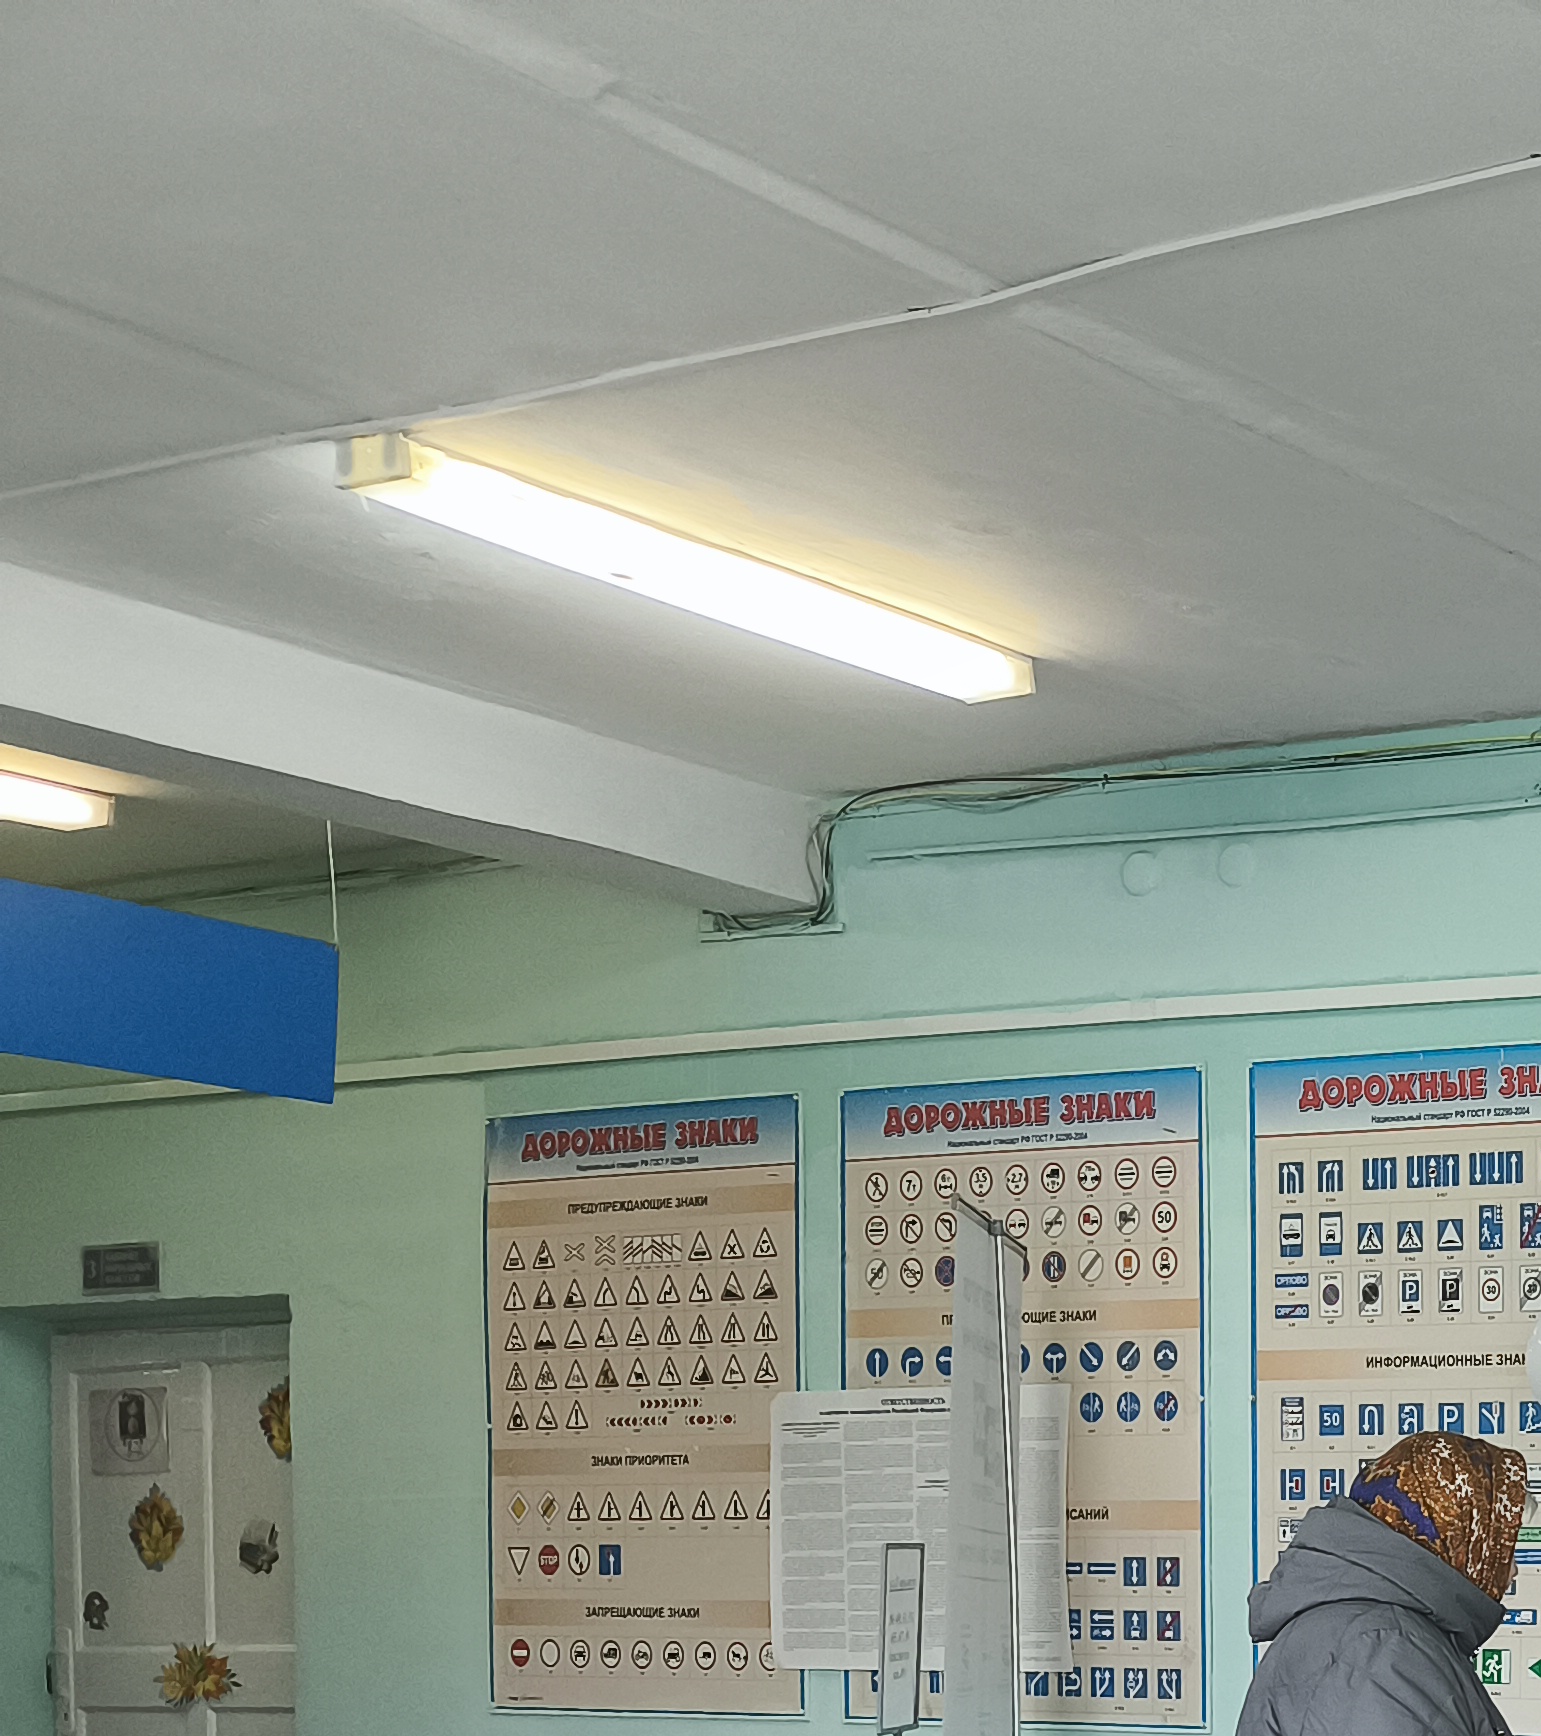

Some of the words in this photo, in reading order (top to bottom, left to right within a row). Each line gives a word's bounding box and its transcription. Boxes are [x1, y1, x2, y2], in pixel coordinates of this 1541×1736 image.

[1299, 1067, 1487, 1112] ДОРОЖНЫЕ
[883, 1096, 1051, 1138] ДОРОЖНЫЕ
[1059, 1090, 1157, 1124] ЗНАКИ
[521, 1122, 667, 1162] ДОРОЖНЫЕ
[674, 1116, 759, 1150] ЗНАКИ
[567, 1198, 673, 1215] ПРЕДУПРЕЖДАЮЩИЕ
[674, 1194, 709, 1210] ЗНАКИ
[1157, 1209, 1173, 1225] 50
[1486, 1285, 1497, 1295] 30
[1059, 1310, 1097, 1323] ЗНАКИ
[1366, 1354, 1494, 1370] ИНФОРМАЦИОННЫЕ
[1322, 1413, 1341, 1427] 50
[591, 1455, 624, 1467] ЗНАКИ
[624, 1454, 690, 1467] ПРИОРИТЕТА
[585, 1606, 666, 1620] ЗАПРЕЩАЮЩИЕ
[667, 1606, 700, 1619] ЗНАКИ
